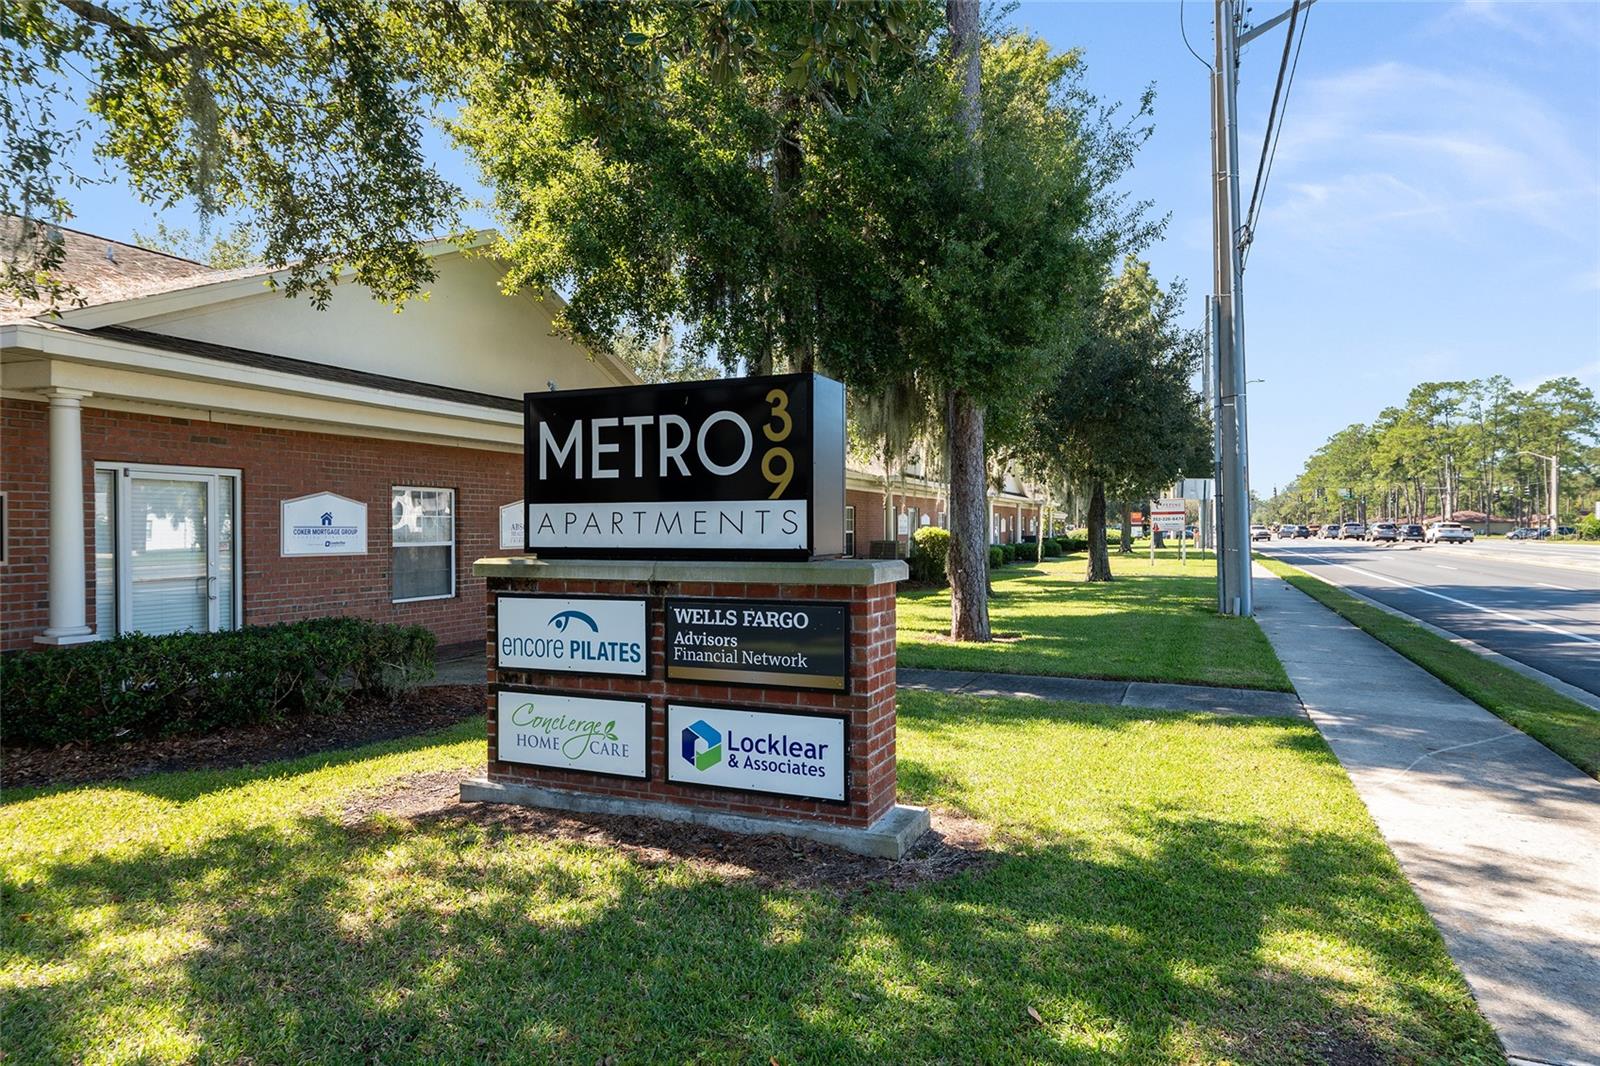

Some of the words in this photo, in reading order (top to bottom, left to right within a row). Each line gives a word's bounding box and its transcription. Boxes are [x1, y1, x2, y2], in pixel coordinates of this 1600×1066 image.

[539, 410, 753, 480] METRO
[537, 509, 799, 535] APARTMENTS
[674, 608, 738, 626] WELLS
[742, 609, 809, 629] FARGO
[502, 633, 564, 659] encore
[570, 639, 641, 663] PILATES
[674, 631, 738, 647] Advisors
[674, 647, 738, 664] Financial
[742, 650, 808, 668] Network
[511, 702, 606, 760] Concierge
[516, 733, 560, 751] HOME
[589, 741, 629, 758] CARE
[727, 730, 829, 761] Locklear
[728, 753, 739, 768] &
[743, 755, 826, 778] Associates
